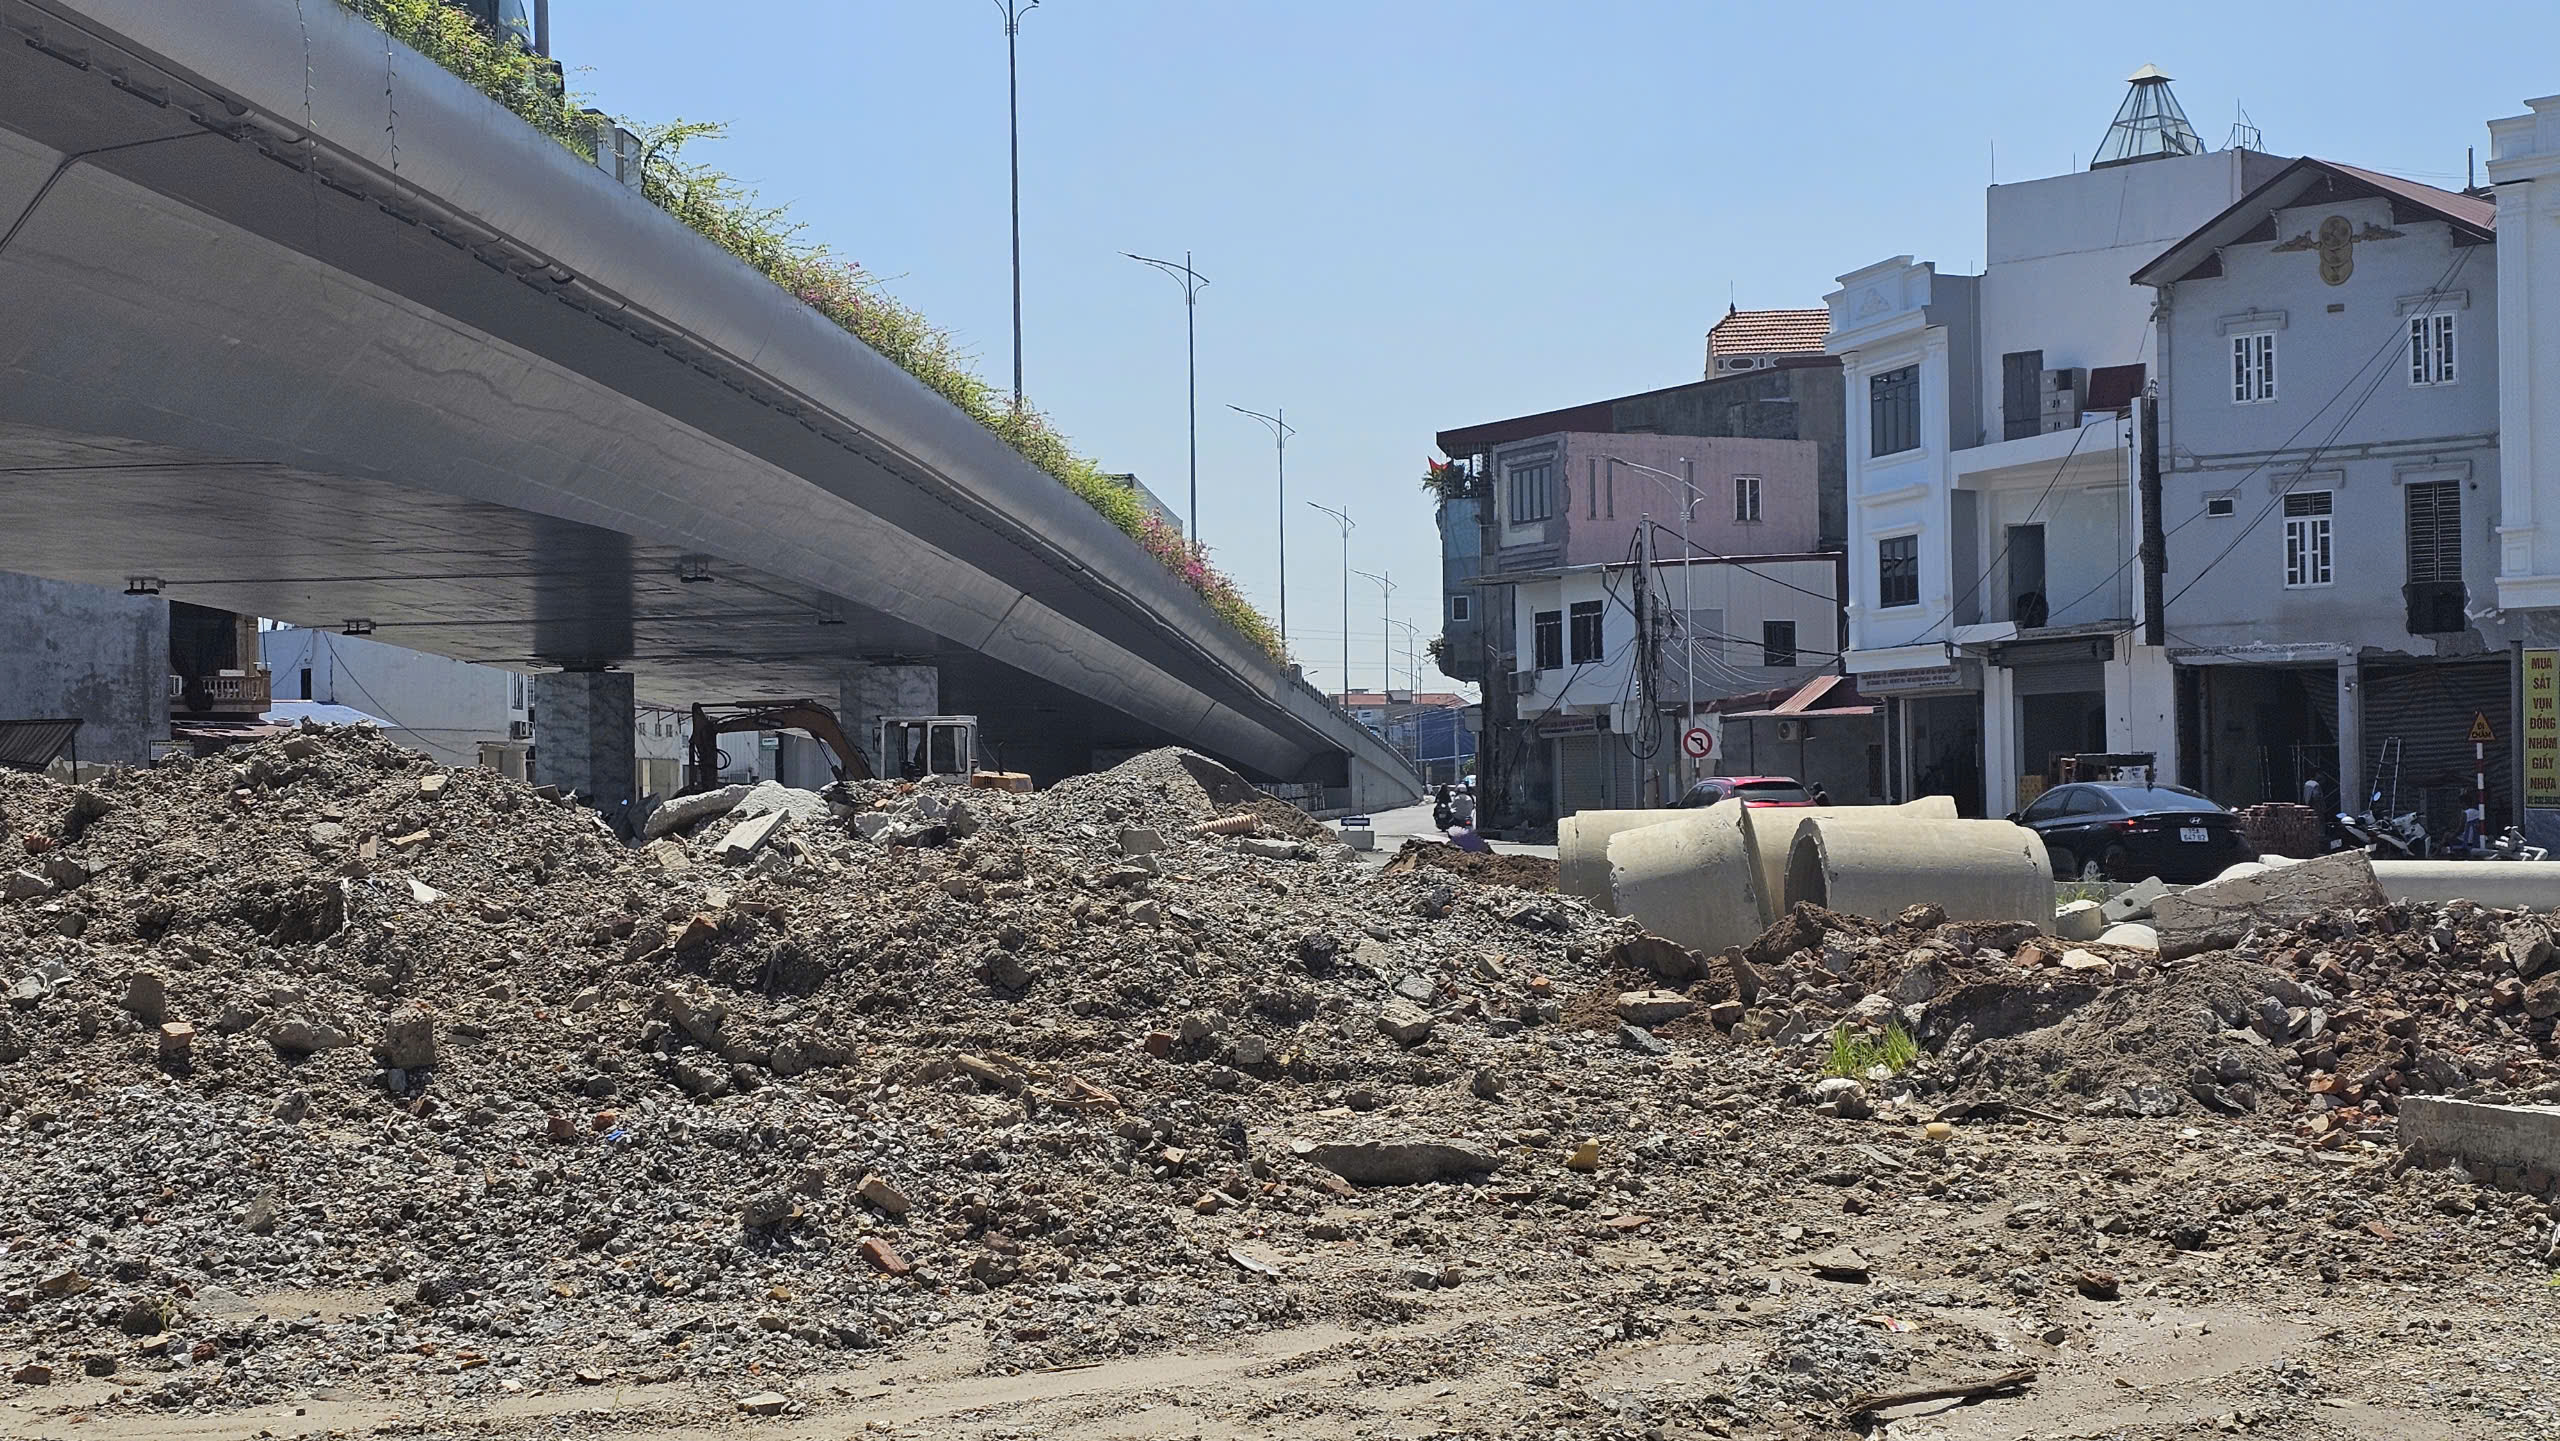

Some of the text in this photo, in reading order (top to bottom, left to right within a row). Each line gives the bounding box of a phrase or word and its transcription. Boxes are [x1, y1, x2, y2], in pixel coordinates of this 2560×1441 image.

[2531, 657, 2552, 669] MUA
[2532, 697, 2552, 712] VỤN
[2530, 776, 2556, 793] NHỰA
